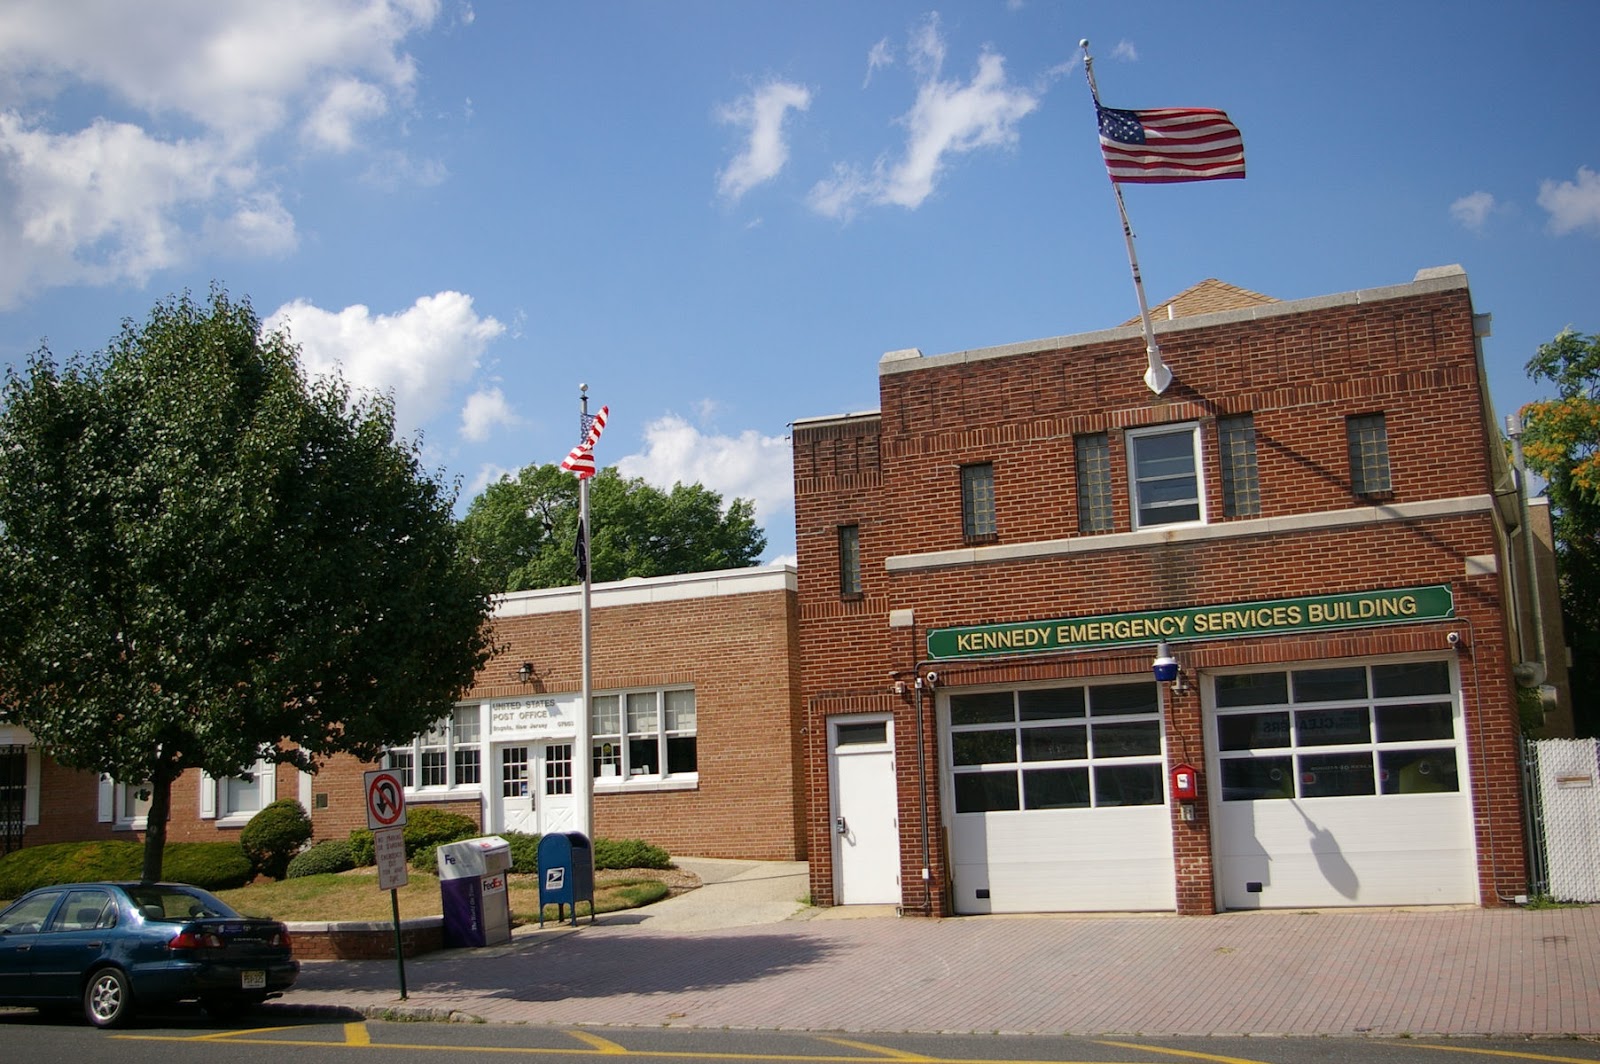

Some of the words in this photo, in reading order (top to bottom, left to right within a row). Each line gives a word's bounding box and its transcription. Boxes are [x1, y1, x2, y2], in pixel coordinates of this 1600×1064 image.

[957, 627, 1051, 652] KENNEDY
[1056, 615, 1187, 644] EMERGENCY
[1193, 605, 1302, 633] SERVICES
[1307, 595, 1417, 623] BUILDING
[492, 701, 521, 710] UNITED
[525, 699, 556, 709] STATES
[493, 712, 514, 721] POST
[520, 710, 548, 719] OFFICE
[483, 878, 503, 891] FedEx
